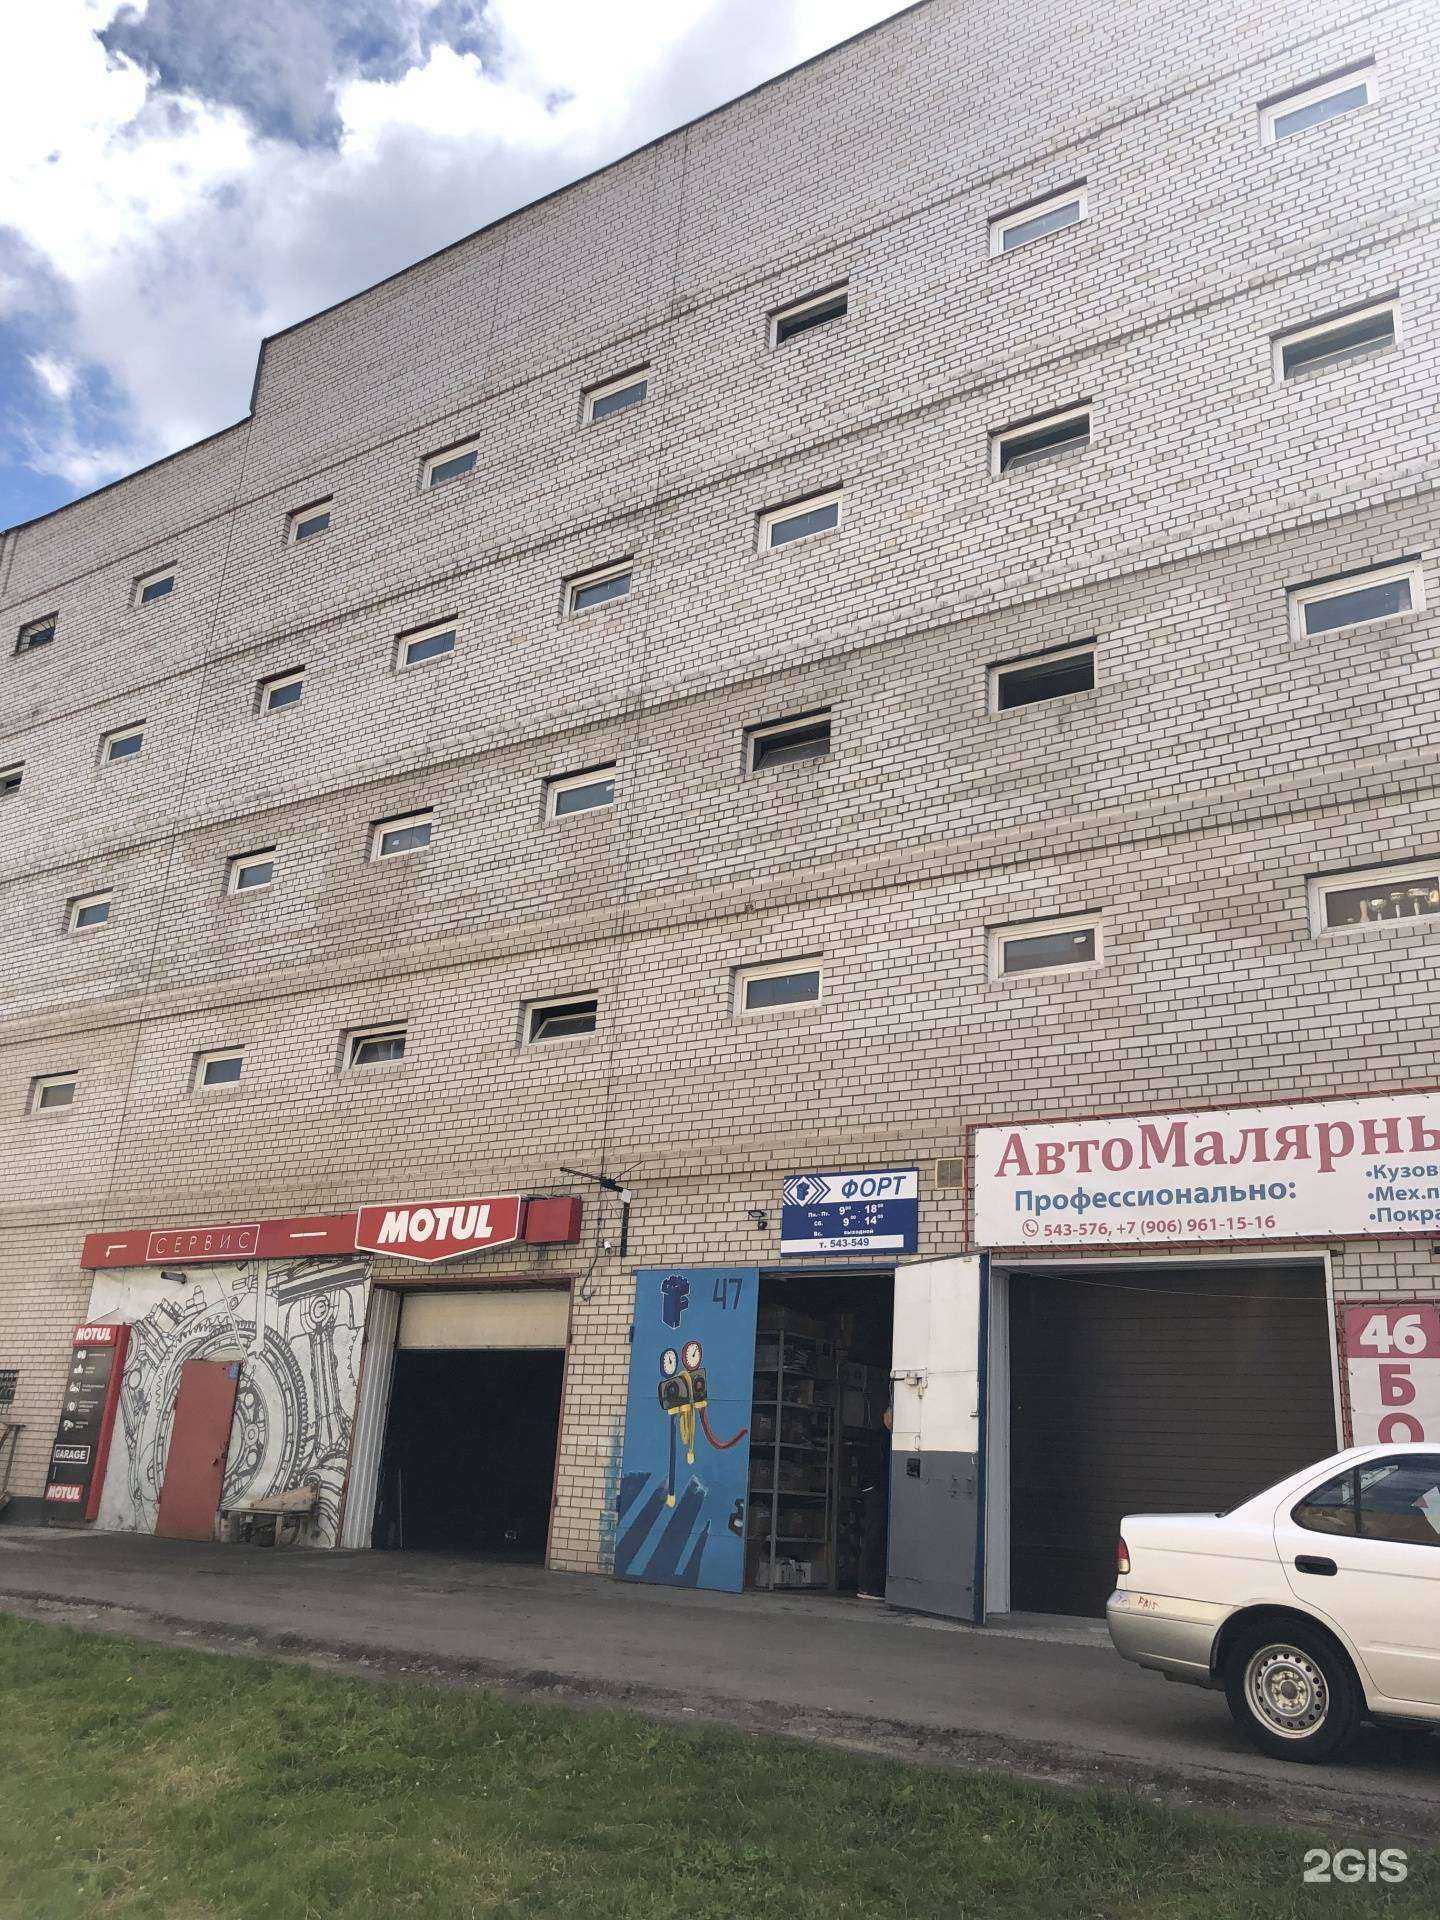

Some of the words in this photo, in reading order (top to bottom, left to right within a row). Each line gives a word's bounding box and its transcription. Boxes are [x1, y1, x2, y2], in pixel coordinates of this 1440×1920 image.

[841, 1176, 907, 1198] ФОРТ
[1014, 1181, 1297, 1216] Профессионально:
[377, 1204, 494, 1244] MOTUL
[1043, 1222, 1112, 1237] 543-576,
[1116, 1221, 1136, 1234] +7
[1140, 1219, 1182, 1235] (906)
[1187, 1215, 1276, 1232] 961-15-16
[155, 1231, 251, 1254] СЕРВИС
[830, 1238, 870, 1248] 543-549
[712, 1278, 743, 1310] 47
[75, 1327, 112, 1341] MOTUL
[1360, 1314, 1427, 1354] 46
[55, 1449, 87, 1460] GARAGE
[46, 1485, 81, 1500] MOTUL
